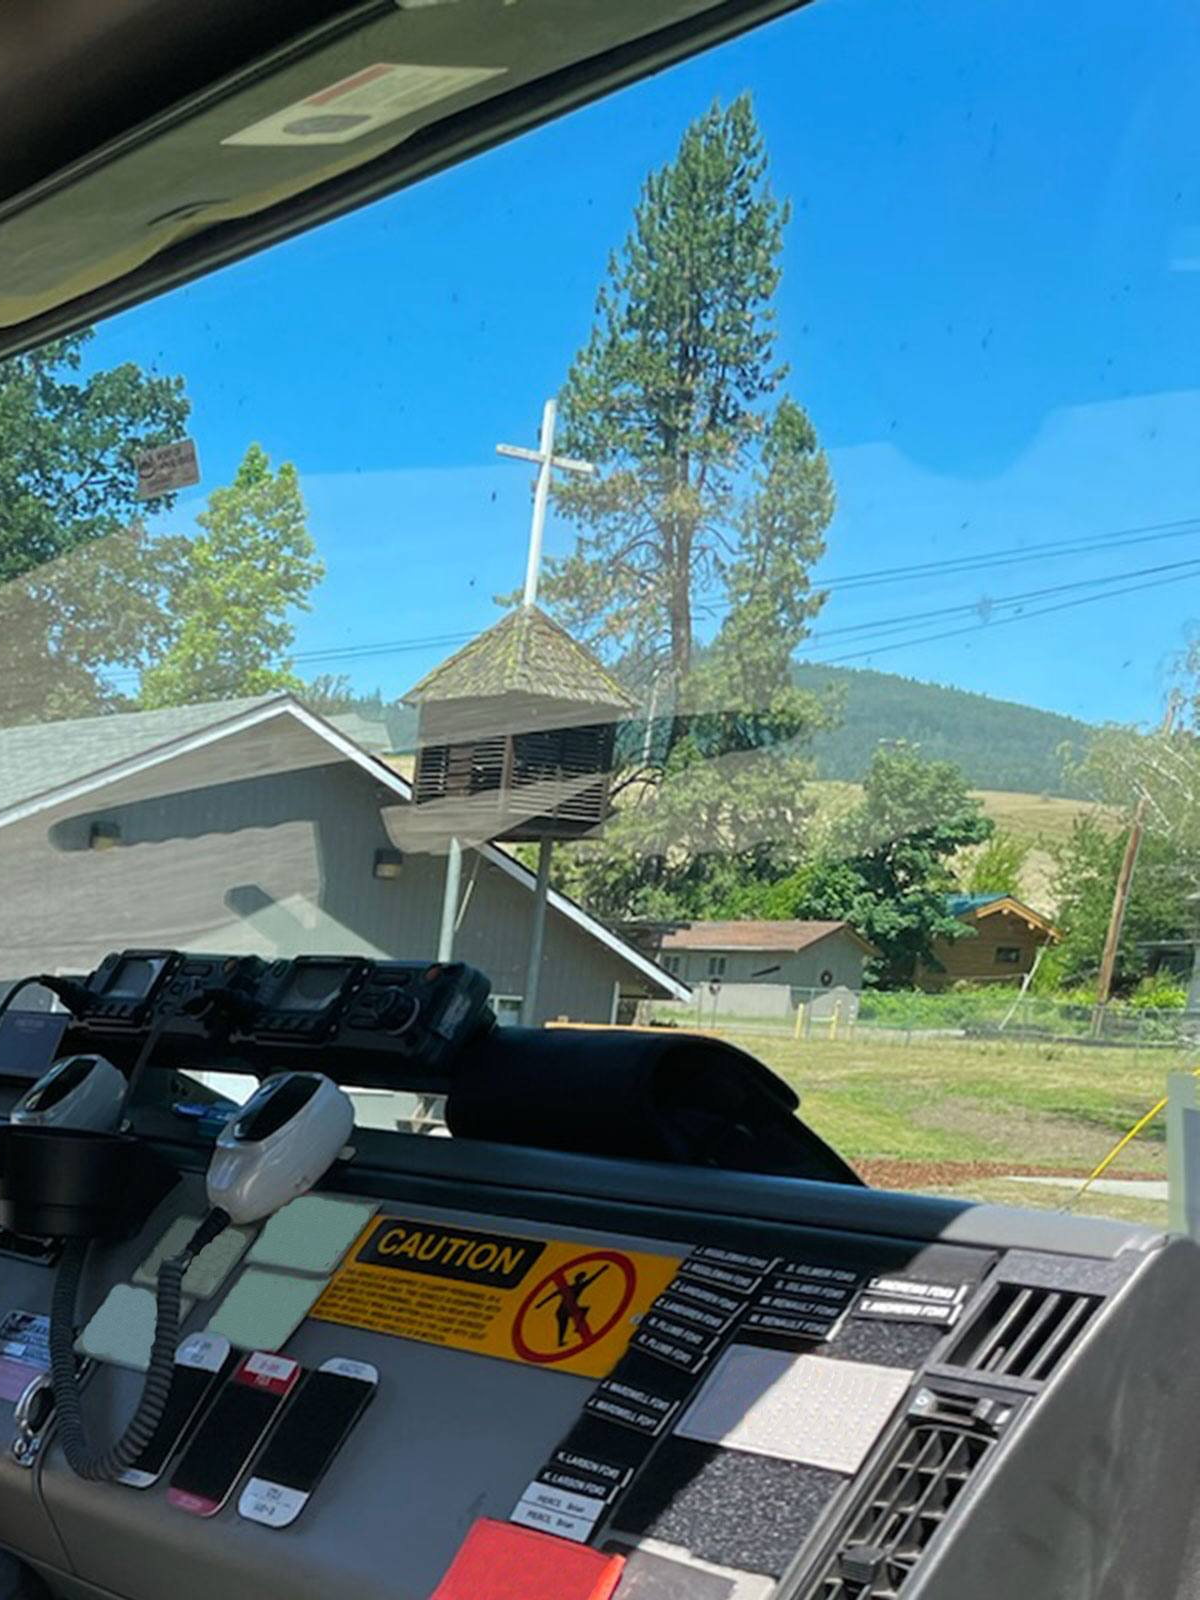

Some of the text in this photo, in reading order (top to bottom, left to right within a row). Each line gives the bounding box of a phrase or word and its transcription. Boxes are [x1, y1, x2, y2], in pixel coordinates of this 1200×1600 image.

[377, 1228, 526, 1276] CAUTION
[565, 1455, 600, 1473] LARSON
[551, 1474, 585, 1490] LARSON
